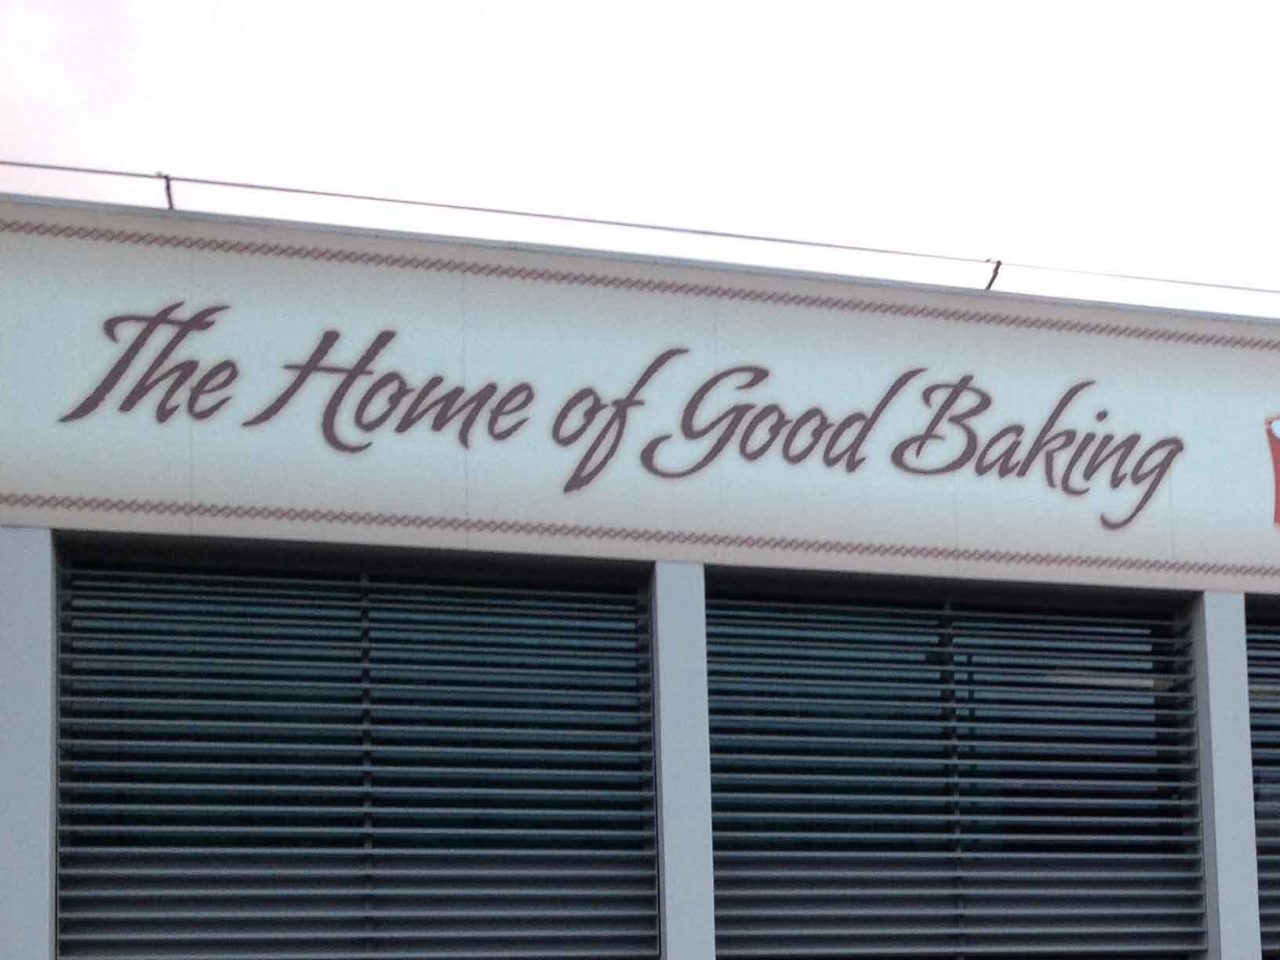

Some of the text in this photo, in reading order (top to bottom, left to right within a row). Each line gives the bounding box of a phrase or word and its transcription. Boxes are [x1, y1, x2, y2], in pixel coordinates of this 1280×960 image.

[58, 301, 1184, 530] The Home of Good Baking
